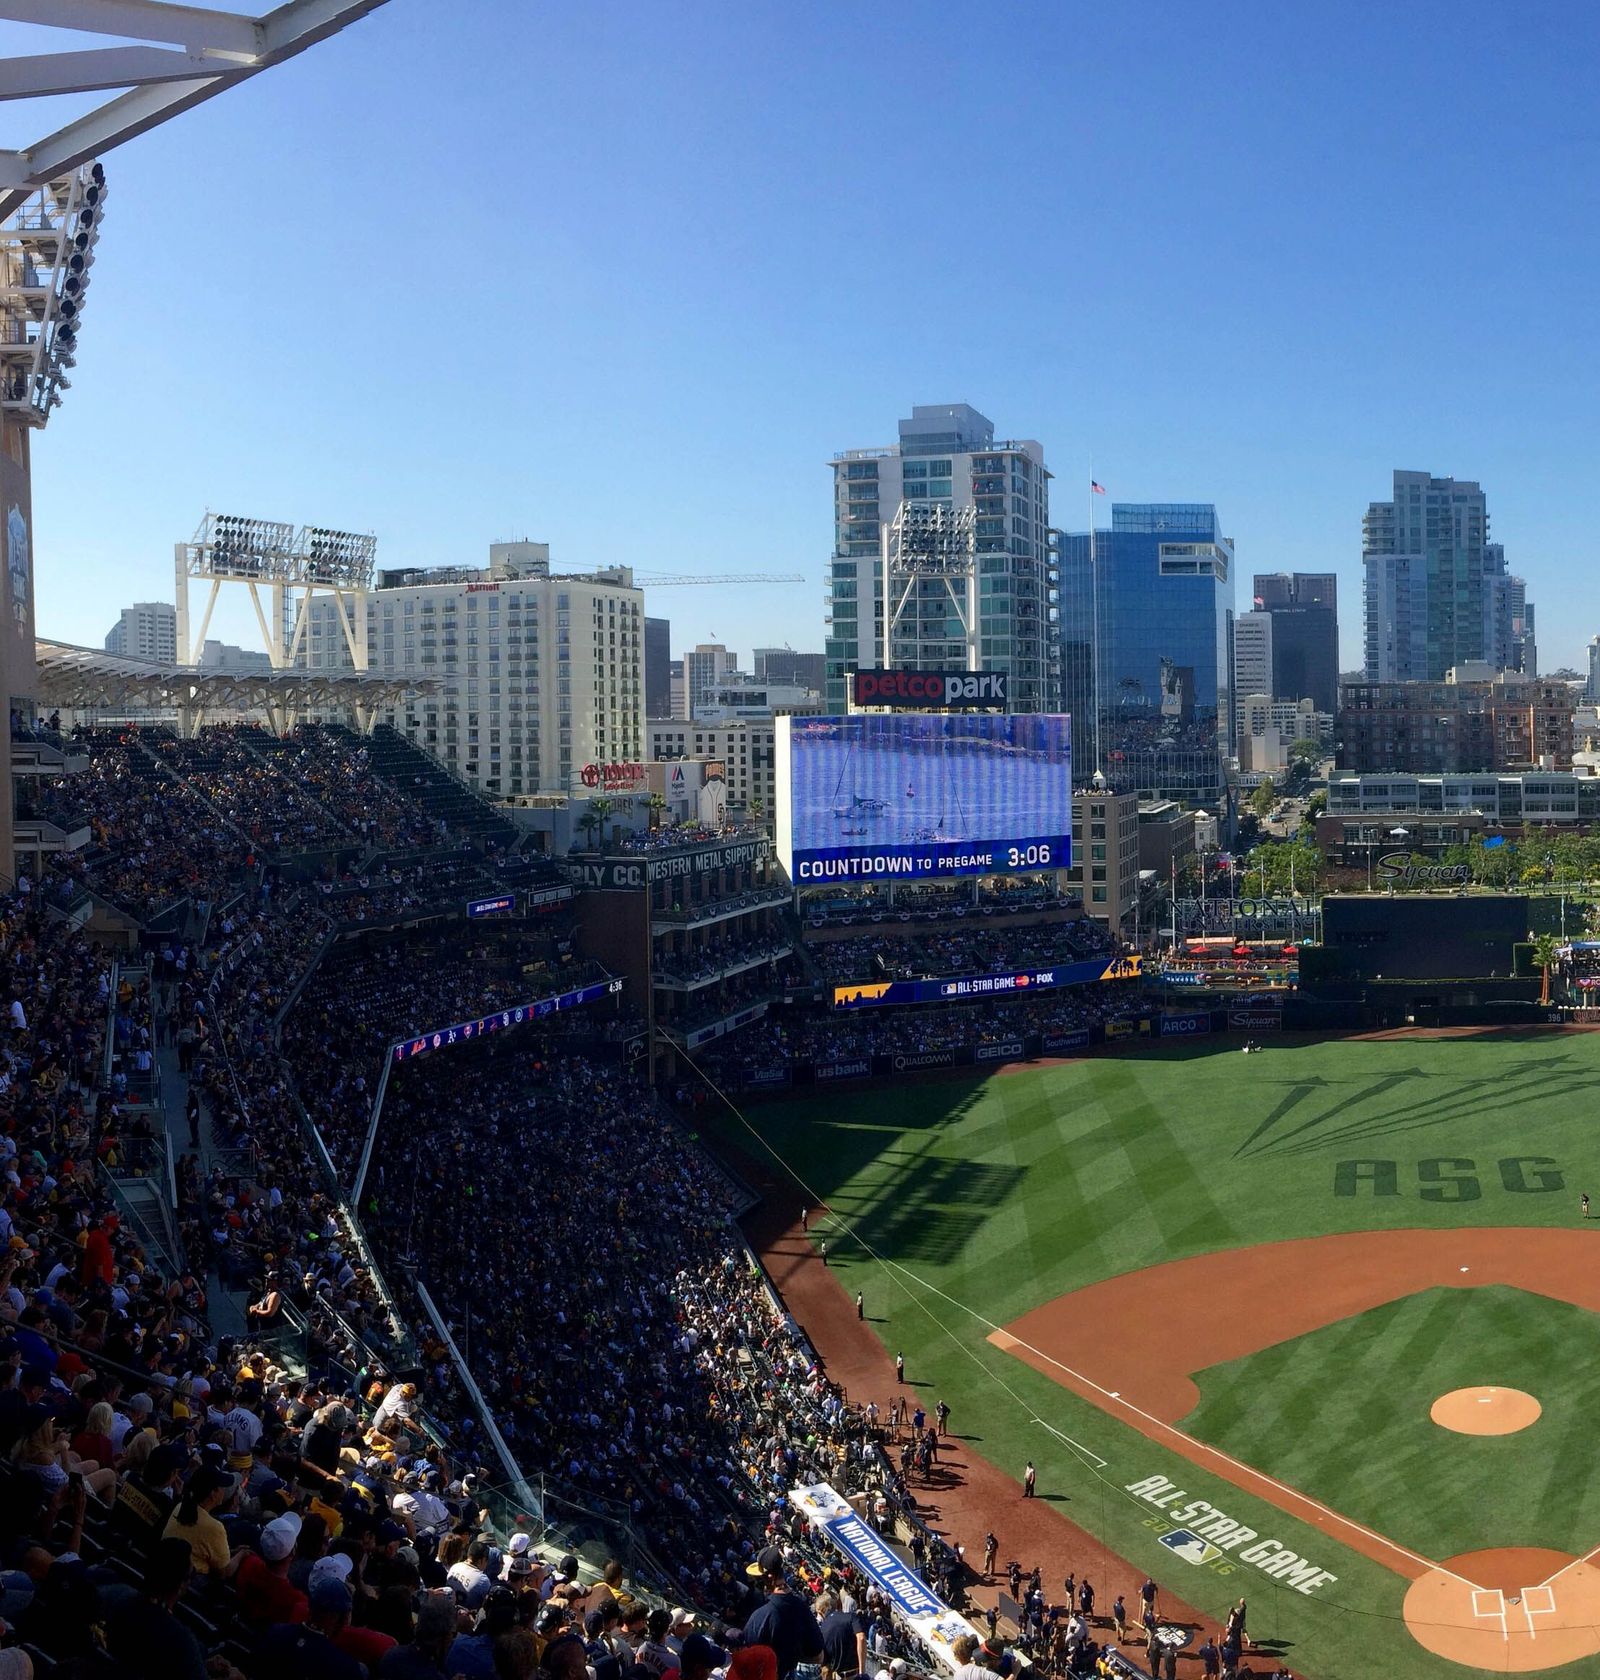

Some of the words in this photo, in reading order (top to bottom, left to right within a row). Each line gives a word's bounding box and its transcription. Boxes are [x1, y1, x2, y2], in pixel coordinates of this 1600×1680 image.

[650, 859, 691, 880] WESTERN
[695, 852, 723, 872] METAL
[725, 845, 754, 865] SUPPLY
[756, 842, 770, 857] CO.
[1008, 845, 1050, 867] 3:06
[799, 857, 913, 878] COUNTDOWN
[917, 859, 931, 870] TO
[938, 854, 992, 868] PREGAME
[1377, 851, 1471, 887] Sycuan
[1166, 898, 1317, 918] NATIONAL
[1178, 917, 1306, 932] UNIVERSITY
[609, 981, 622, 993] 4:36
[994, 976, 1015, 989] GAME
[1037, 973, 1053, 984] FOX
[1163, 1020, 1196, 1032] ARCO
[1230, 1012, 1276, 1028] Sycuan
[1547, 1013, 1561, 1023] 396
[1046, 1036, 1082, 1048] Southwest
[977, 1043, 1022, 1059] GEICO
[894, 1054, 951, 1070] QUALCOMM
[224, 1411, 249, 1431] ILLIAMS
[836, 1520, 896, 1573] NATIONAL
[882, 1570, 934, 1611] LEAGUE
[1239, 1539, 1339, 1595] GAME
